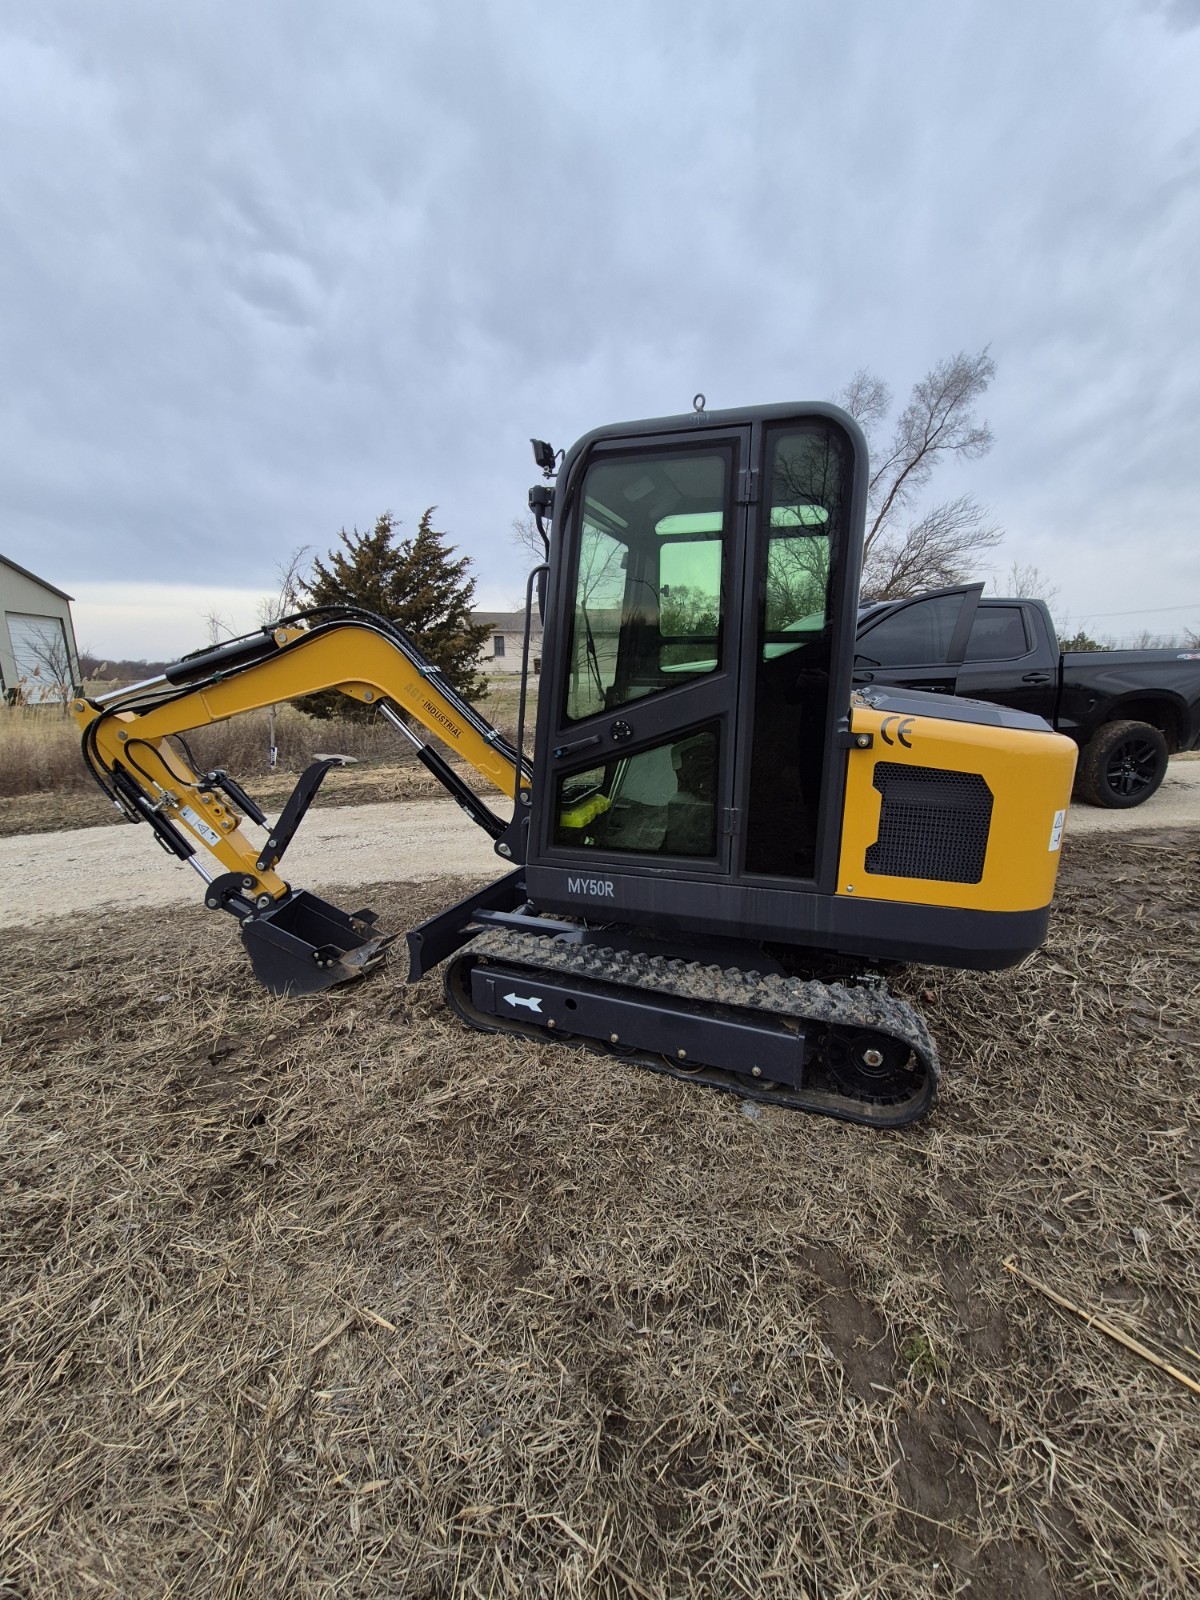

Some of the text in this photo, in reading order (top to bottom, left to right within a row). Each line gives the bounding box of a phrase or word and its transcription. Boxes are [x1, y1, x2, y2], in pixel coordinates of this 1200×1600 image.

[423, 700, 462, 739] INDUSTRIAL
[880, 715, 916, 749] CE
[567, 877, 615, 898] MY50R
